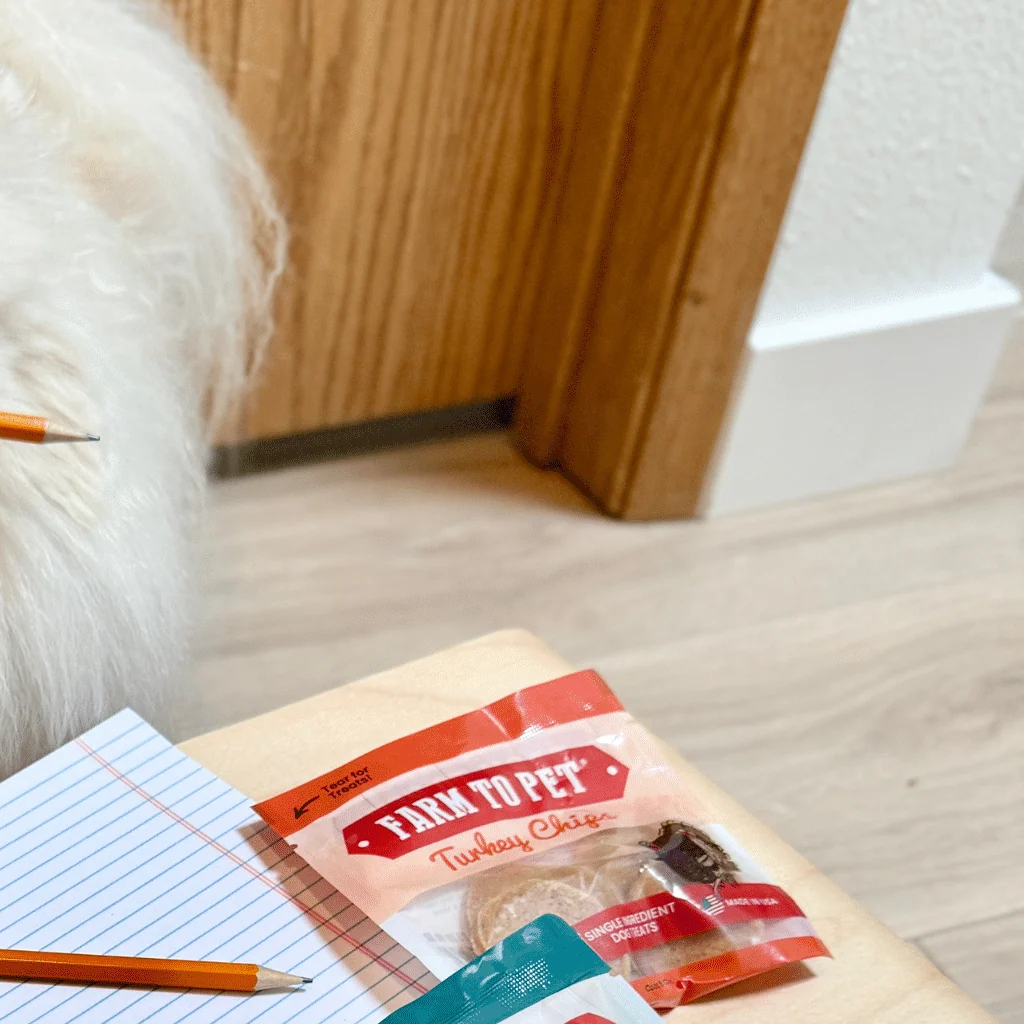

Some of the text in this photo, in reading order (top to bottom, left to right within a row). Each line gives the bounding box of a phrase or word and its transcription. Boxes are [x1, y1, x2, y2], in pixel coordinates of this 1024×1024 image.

[321, 766, 368, 793] Tear for
[328, 774, 373, 799] Treats!
[375, 787, 479, 841] FARM
[467, 774, 521, 809] TO
[429, 831, 534, 871] Turkey
[584, 902, 675, 942] SINGLE IEDIENT
[610, 928, 632, 943] DOG
